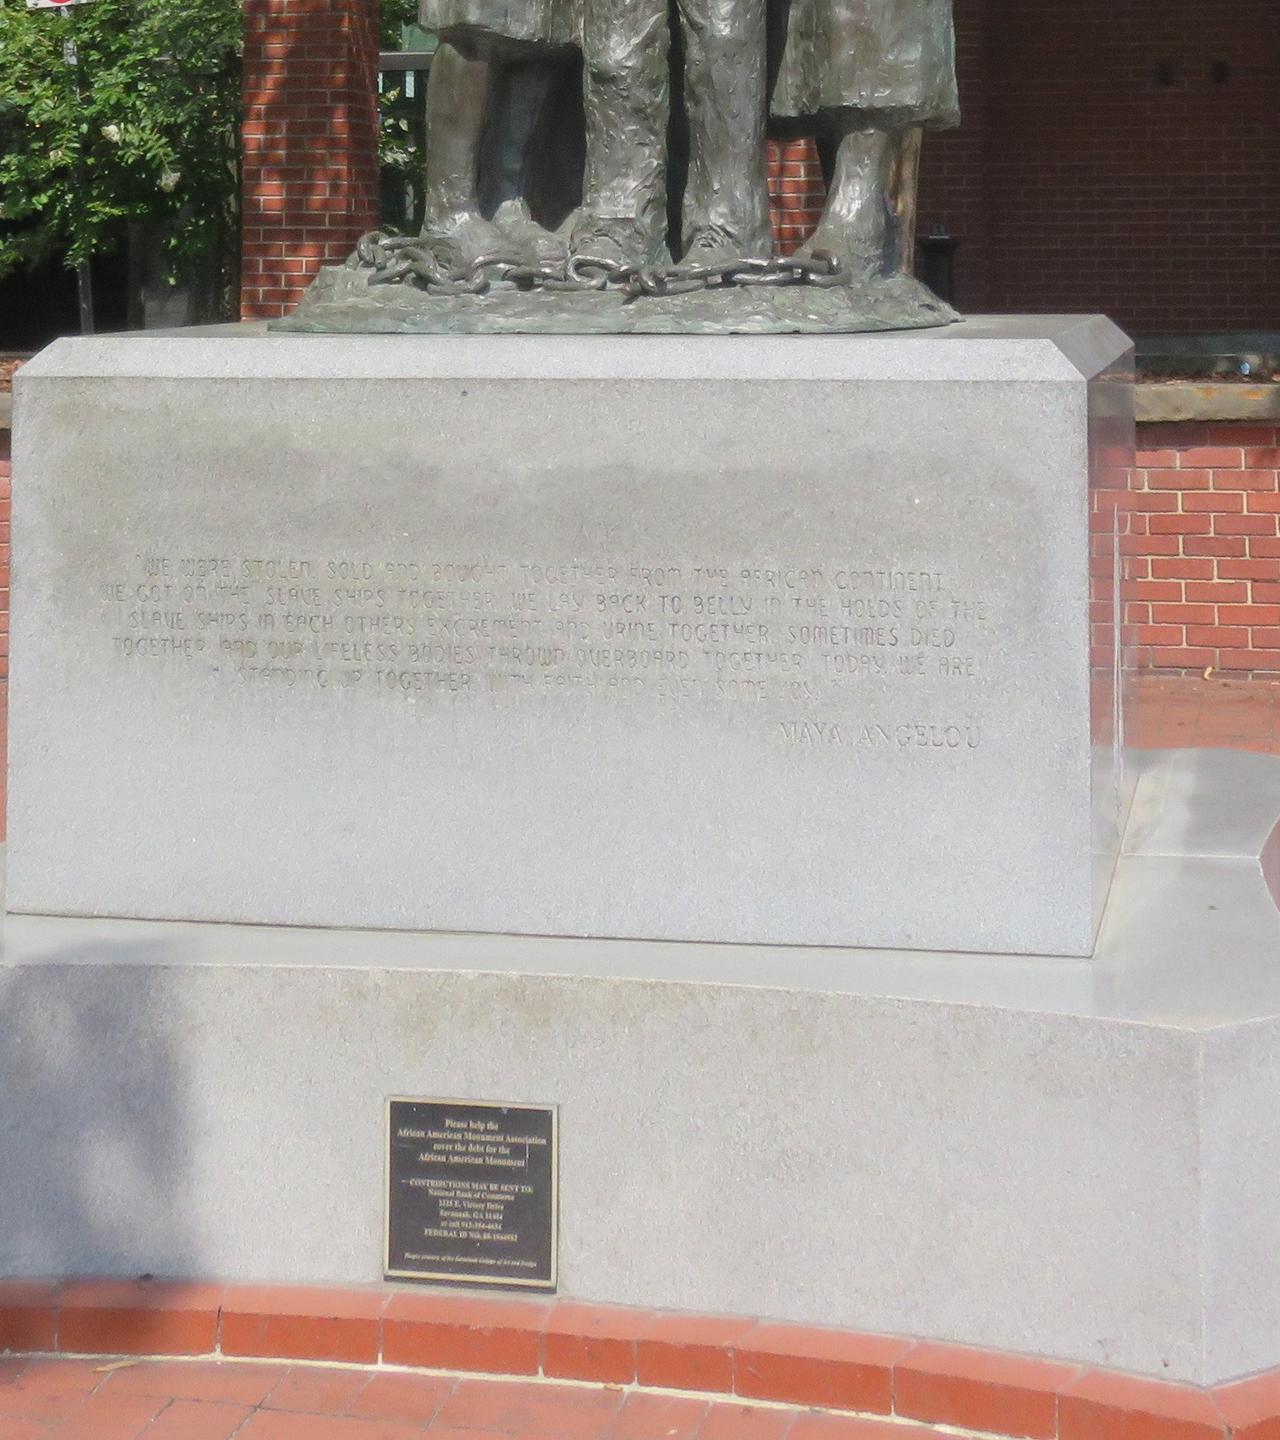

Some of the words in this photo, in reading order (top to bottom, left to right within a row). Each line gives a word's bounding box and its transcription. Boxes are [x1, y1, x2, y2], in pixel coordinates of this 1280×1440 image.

[144, 559, 170, 577] WE
[180, 560, 231, 578] WERE
[327, 561, 375, 580] SOLD
[520, 564, 619, 585] TOGETHER
[630, 566, 682, 587] FROM
[693, 568, 729, 588] THE
[740, 569, 823, 589] AFRICAN
[101, 584, 125, 603] WE
[136, 584, 174, 603] GOT
[215, 586, 251, 605] THE
[266, 587, 321, 607] SLAVE
[333, 588, 386, 608] SHIPS
[511, 591, 537, 611] WE
[596, 593, 647, 613] BACK
[658, 594, 683, 614] TO
[693, 596, 753, 616] BELLY
[792, 598, 828, 618] THE
[840, 599, 904, 619] HOLDS
[915, 600, 939, 619] OF
[950, 600, 987, 621] THE
[128, 611, 185, 630] SLAVE
[195, 612, 250, 632] SHIPS
[284, 614, 334, 633] EACH
[343, 615, 415, 635] OTHERS
[426, 617, 542, 640] EXCREMENT
[555, 620, 590, 640] AND
[602, 621, 656, 641] URINE
[787, 625, 900, 647] SOMETIMES
[910, 628, 956, 648] DIED
[220, 639, 258, 659] AND
[408, 644, 475, 665] BODIES
[489, 646, 566, 667] THROWN
[576, 648, 689, 670] OVERBOARD
[898, 655, 926, 676] WE
[938, 656, 975, 677] ARE
[780, 720, 842, 747] MAYA
[859, 723, 982, 749] ANGELOU
[445, 1119, 469, 1129] Please
[470, 1120, 486, 1132] help
[487, 1121, 499, 1131] the
[397, 1128, 425, 1138] African
[427, 1130, 462, 1140] American
[464, 1132, 504, 1142] Monument
[506, 1135, 547, 1145] Association
[433, 1144, 453, 1152] cover
[454, 1143, 467, 1152] the
[468, 1143, 485, 1153] debt
[486, 1145, 497, 1154] for
[499, 1146, 510, 1155] the
[419, 1152, 447, 1162] African
[448, 1154, 483, 1164] American
[485, 1156, 525, 1167] Monument
[410, 1179, 470, 1190] CONTRIBUTIONS
[471, 1181, 487, 1191] MAY
[500, 1184, 519, 1193] SENT
[428, 1189, 455, 1198] National
